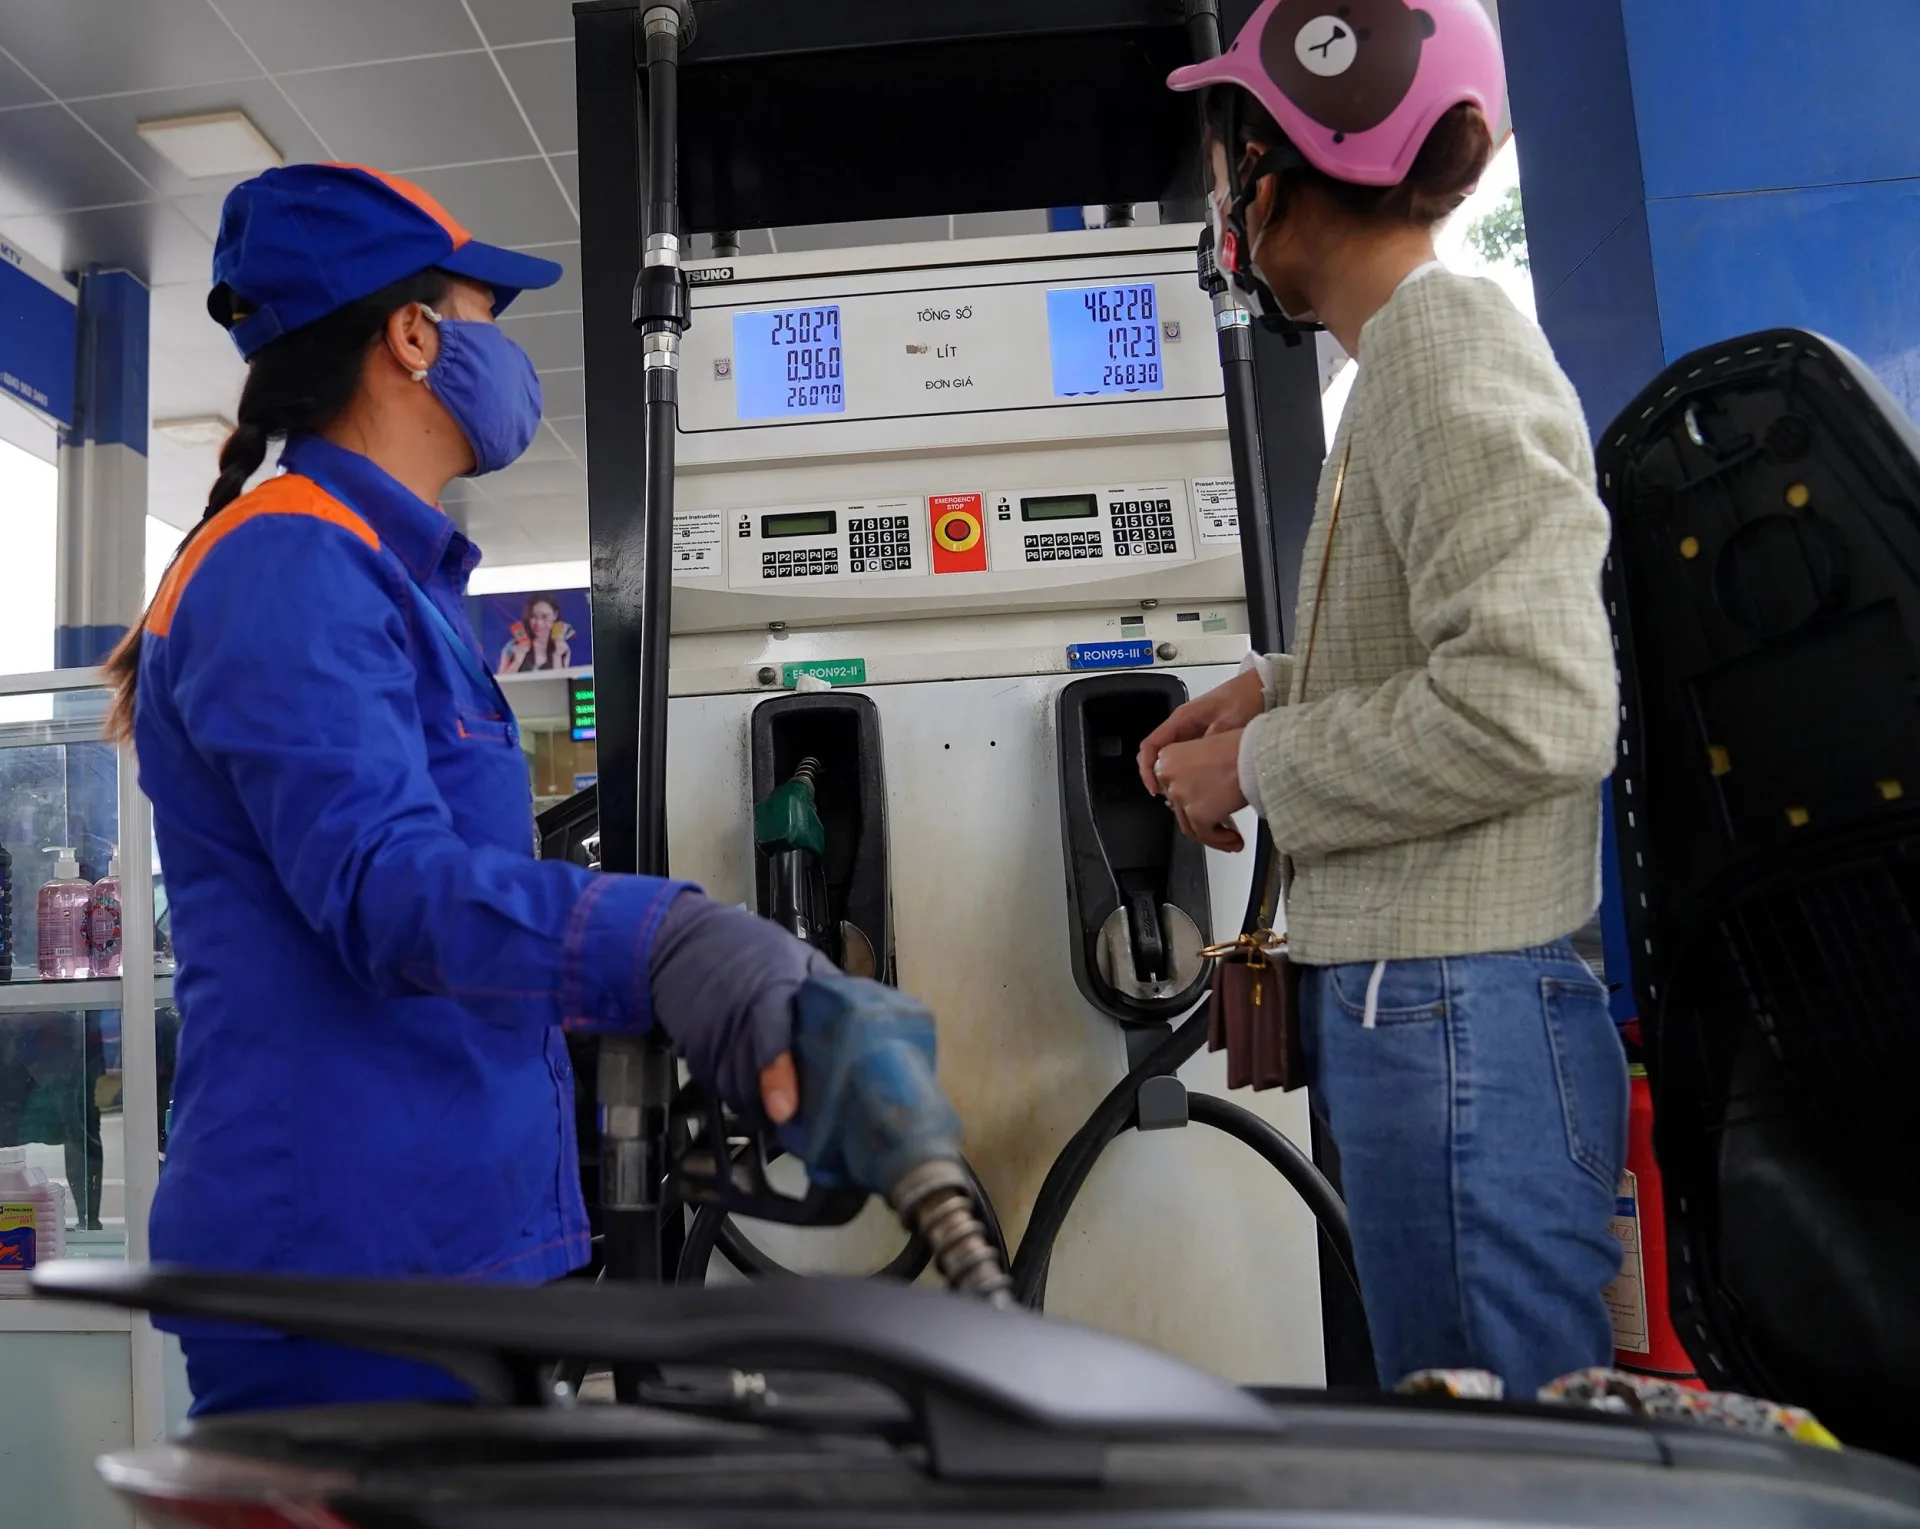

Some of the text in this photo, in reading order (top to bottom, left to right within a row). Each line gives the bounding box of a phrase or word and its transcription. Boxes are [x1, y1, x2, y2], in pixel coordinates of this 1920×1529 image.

[1085, 288, 1152, 322] 46228
[917, 305, 972, 321] TỔNG SỐ
[772, 310, 838, 345] 25027
[1109, 325, 1155, 361] 1,723
[937, 344, 957, 358] LÍT
[788, 347, 840, 383] 0,960
[1103, 363, 1157, 386] 26830
[925, 375, 973, 389] ĐƠN GIÁ
[788, 384, 841, 407] 26070
[934, 496, 975, 504] EMERGENCY
[1113, 504, 1121, 513] 7
[1129, 503, 1137, 512] 8
[1144, 502, 1152, 511] 9
[851, 520, 859, 530] 7
[867, 520, 875, 529] 8
[882, 519, 890, 528] 9
[1115, 517, 1123, 527] 4
[1130, 517, 1138, 526] 5
[1146, 516, 1154, 525] 6
[852, 534, 860, 544] 4
[868, 533, 875, 543] 5
[883, 532, 891, 542] 6
[1026, 534, 1100, 546] P1 P2 P3 P4 P5
[1117, 531, 1123, 541] 1
[1132, 530, 1140, 540] 2
[1148, 529, 1156, 539] 3
[853, 548, 859, 558] 1
[868, 547, 876, 556] 2
[884, 546, 891, 555] 3
[1027, 551, 1039, 559] P6
[1058, 550, 1070, 558] P8
[1074, 549, 1086, 557] P9
[1089, 548, 1102, 556] P10
[1118, 545, 1126, 555] 0
[1133, 544, 1142, 553] C
[779, 553, 791, 561] P2
[794, 552, 806, 560] P3
[810, 551, 821, 559] P4
[764, 564, 838, 576] P6 P7 P8 P9 P10
[853, 561, 861, 571] 0
[868, 560, 878, 570] C
[1083, 648, 1140, 661] RON95-III
